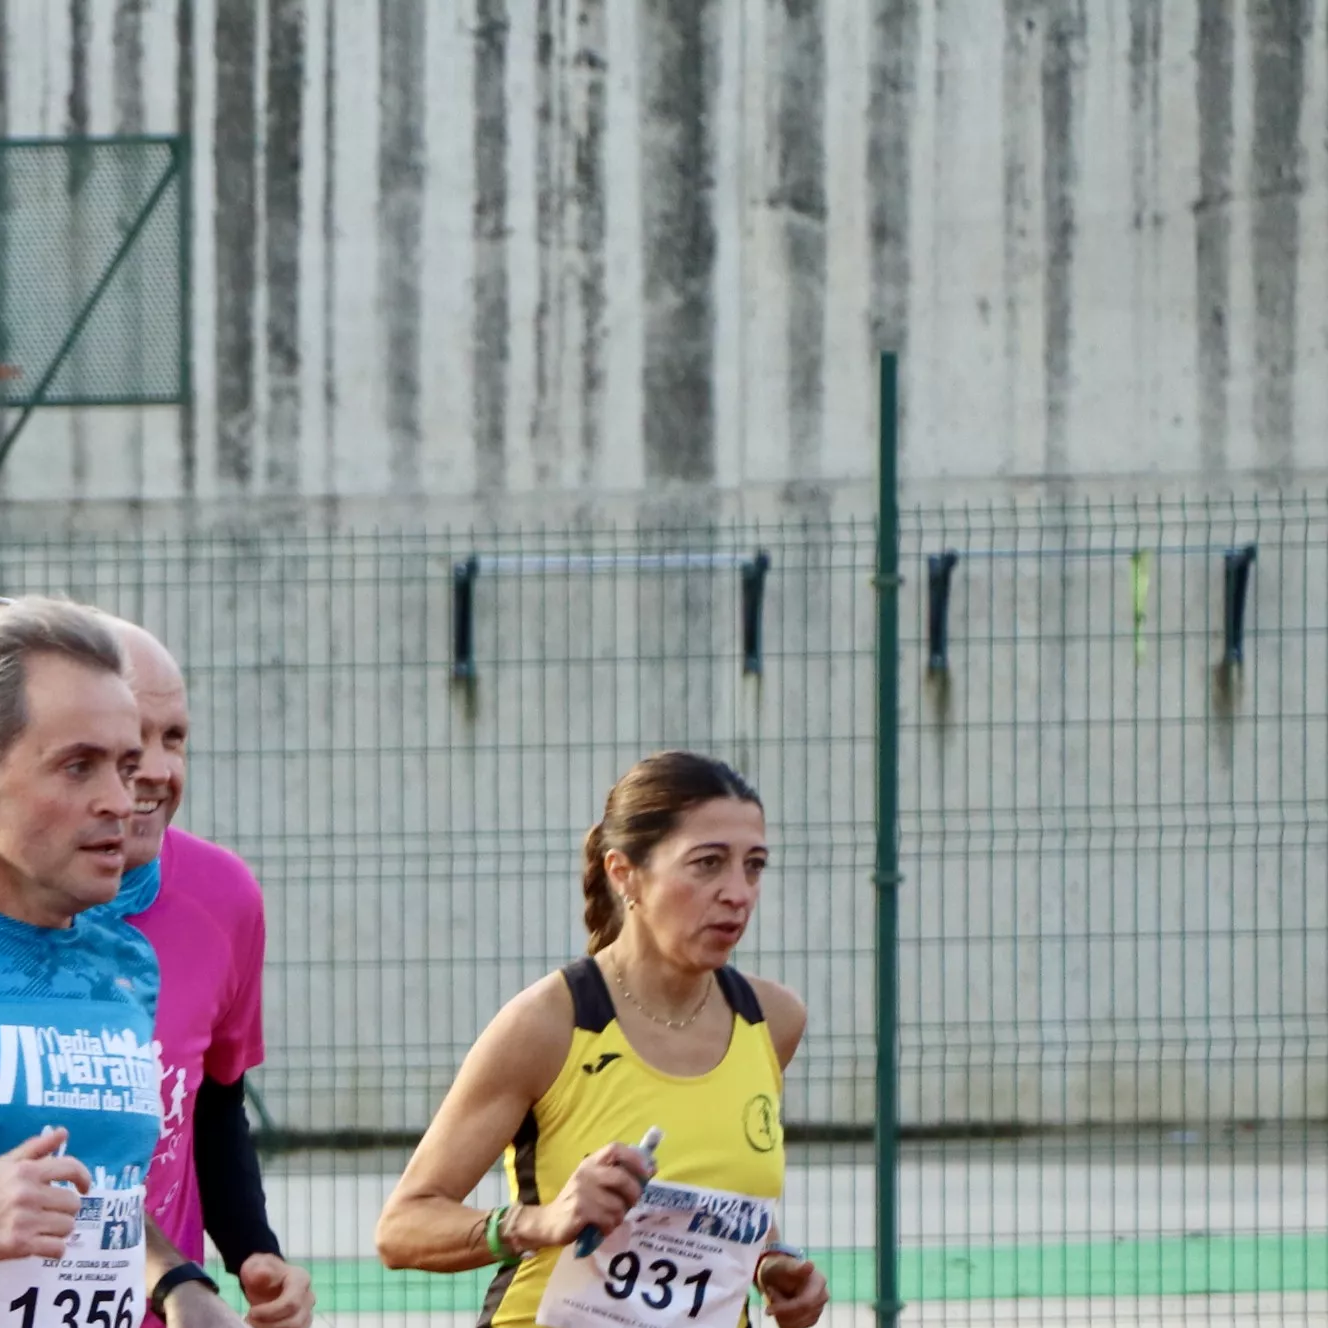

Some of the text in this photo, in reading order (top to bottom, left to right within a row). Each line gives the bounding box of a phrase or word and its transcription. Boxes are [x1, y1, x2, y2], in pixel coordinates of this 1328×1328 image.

[37, 1026, 104, 1057] Media
[43, 1087, 101, 1111] ciudad
[102, 1089, 122, 1112] de
[604, 1250, 714, 1319] 931
